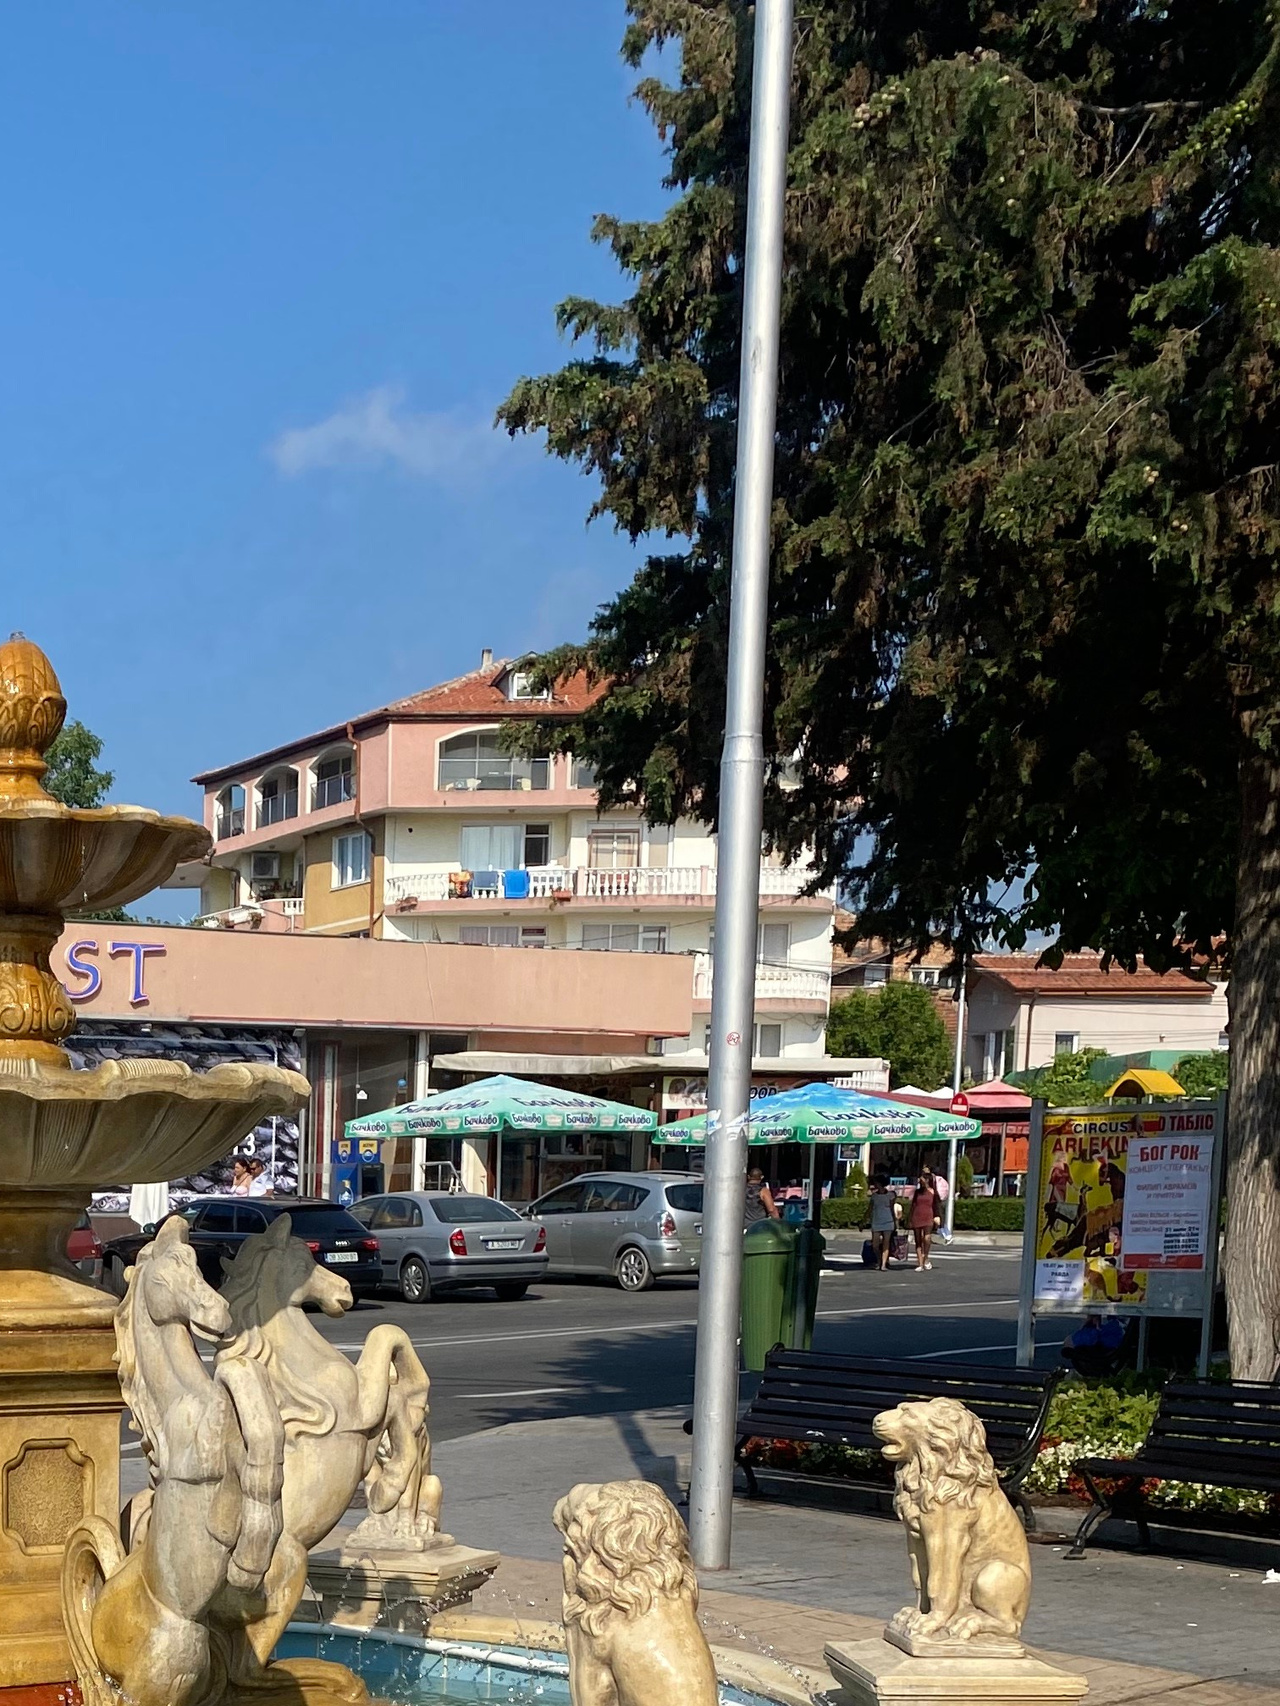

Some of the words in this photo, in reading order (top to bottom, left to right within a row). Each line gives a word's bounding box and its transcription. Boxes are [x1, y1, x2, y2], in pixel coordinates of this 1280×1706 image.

[463, 1114, 498, 1127] Бачково
[511, 1113, 542, 1125] Бачково
[565, 1113, 597, 1125] Бачково
[618, 1113, 652, 1126] Бачково
[817, 1108, 926, 1122] Бачково
[350, 1121, 386, 1133] Бачково
[408, 1118, 442, 1131] Бачково
[937, 1120, 977, 1133] Бачково
[1073, 1121, 1129, 1134] CIRCUS
[1170, 1114, 1214, 1131] ТАБЛО
[658, 1127, 690, 1139] Бачково
[760, 1126, 793, 1138] Бачково
[806, 1124, 848, 1137] Бачково
[873, 1123, 913, 1136] Бачково
[1140, 1144, 1168, 1162] БОГ
[1170, 1144, 1200, 1161] РОК
